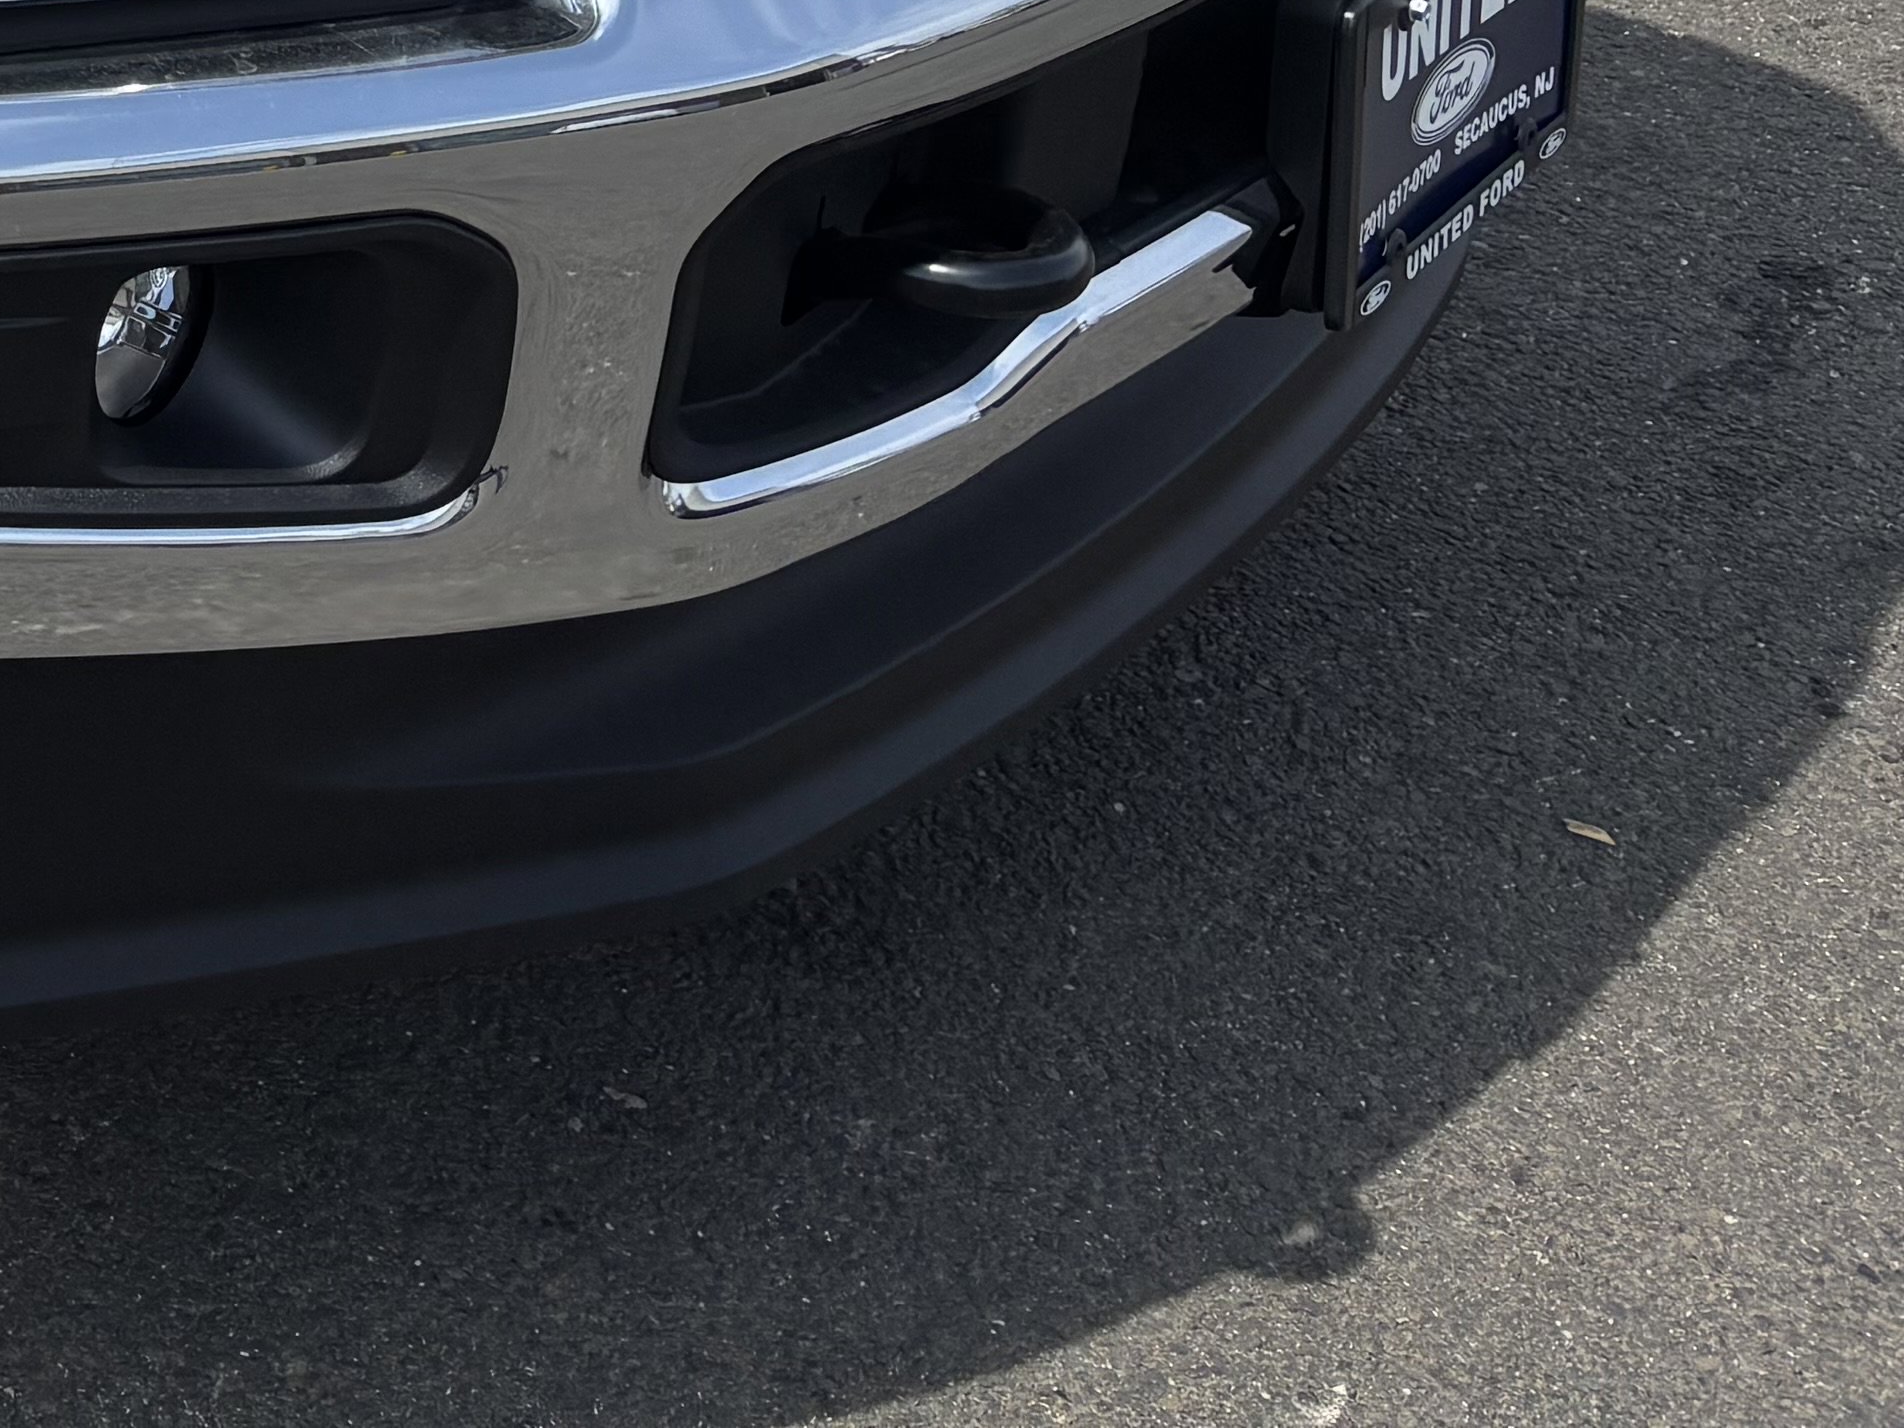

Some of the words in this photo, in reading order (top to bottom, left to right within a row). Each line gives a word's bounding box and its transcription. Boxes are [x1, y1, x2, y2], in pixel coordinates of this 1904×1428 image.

[1429, 58, 1475, 126] Ford
[1454, 83, 1531, 156] SECAUCUS,
[1534, 66, 1556, 99] NJ
[1388, 148, 1442, 216] 617-0700
[1406, 203, 1475, 280] UNITED
[1479, 158, 1525, 218] FORD
